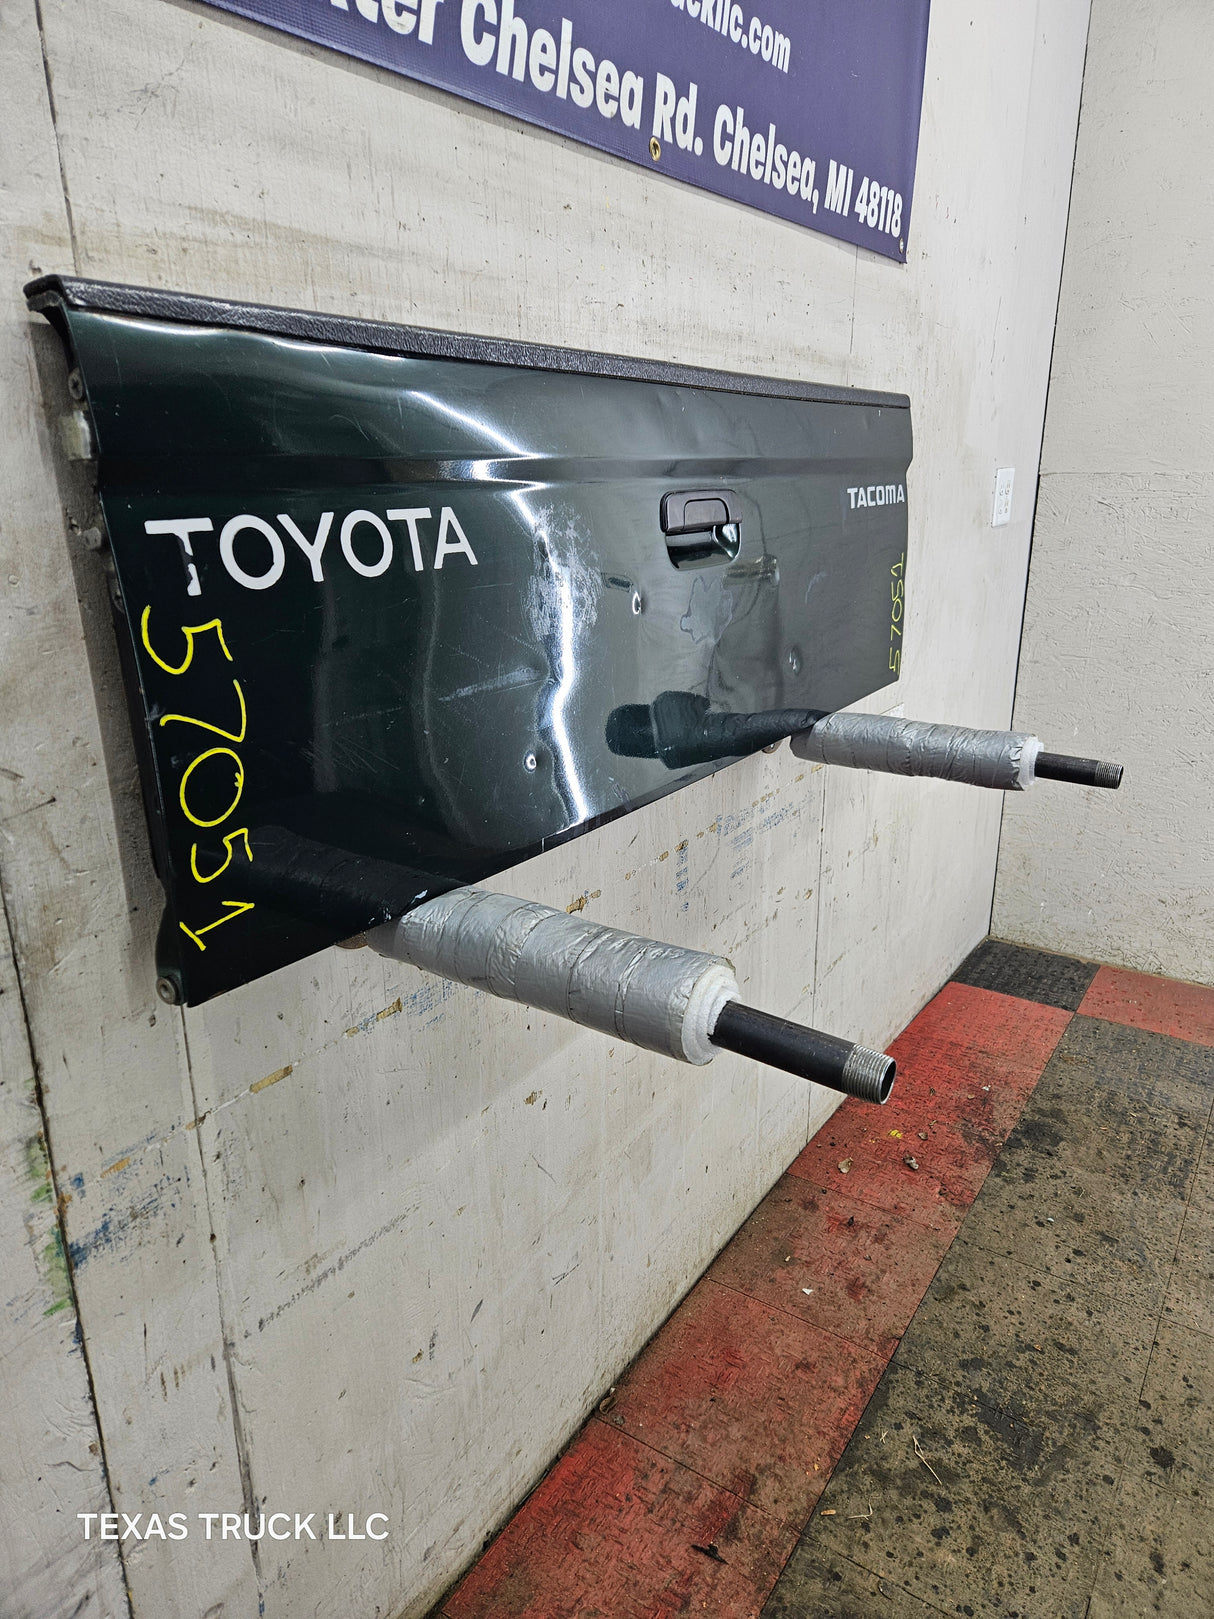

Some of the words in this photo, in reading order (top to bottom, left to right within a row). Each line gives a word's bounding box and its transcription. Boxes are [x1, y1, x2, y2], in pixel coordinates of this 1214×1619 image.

[460, 0, 645, 130] Chelsea
[652, 72, 704, 157] Rd.
[713, 104, 819, 215] Chelsea,
[824, 159, 854, 217] MI
[854, 176, 903, 238] 48118
[144, 506, 479, 597] TOYOTA
[847, 484, 905, 509] TACOMA
[889, 552, 904, 676] 57051
[140, 604, 255, 951] 57051
